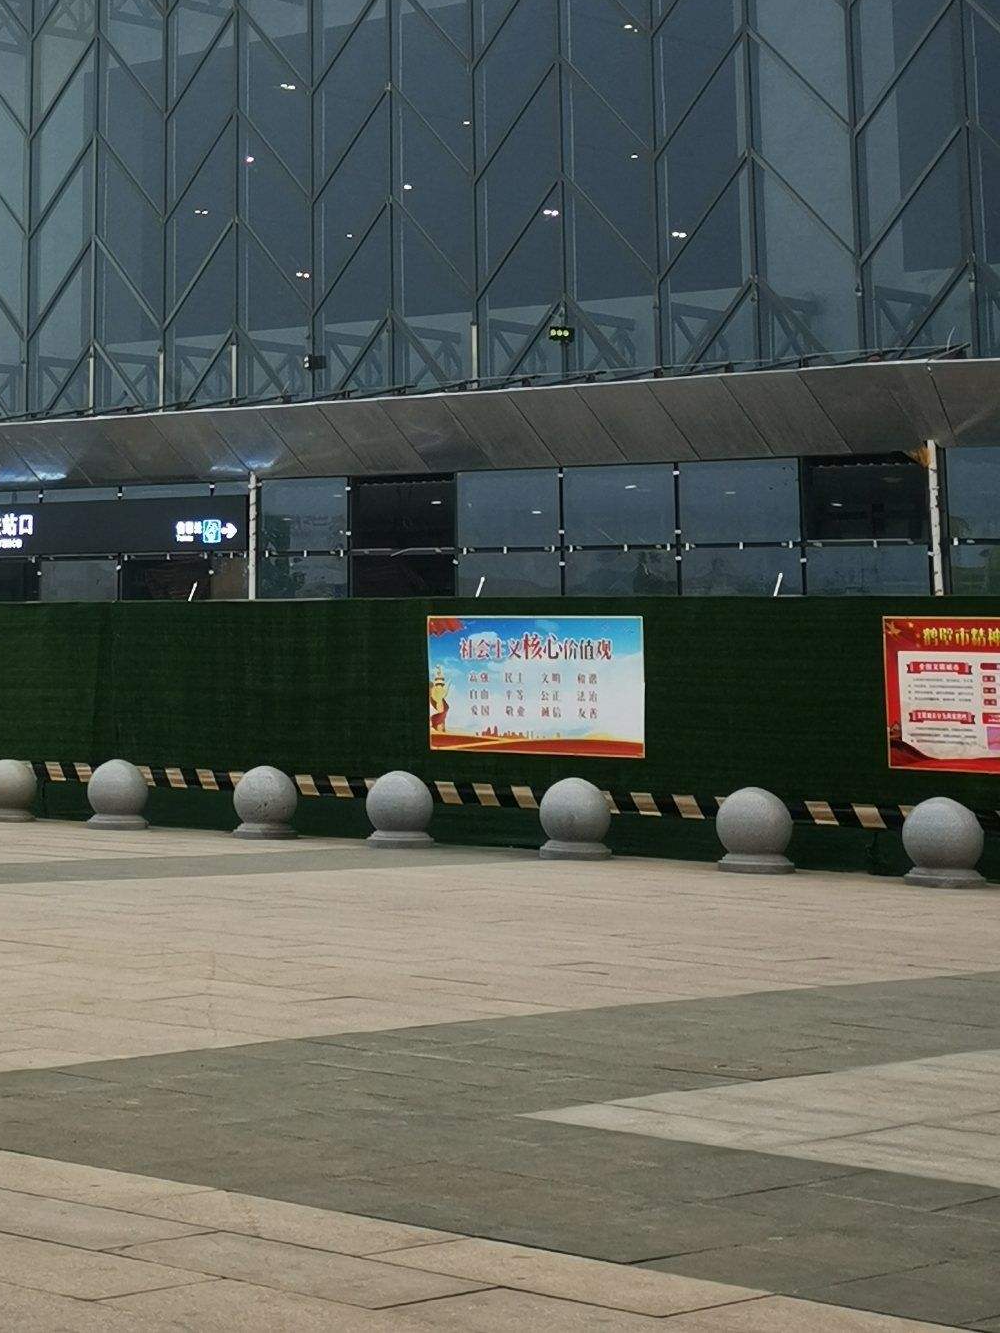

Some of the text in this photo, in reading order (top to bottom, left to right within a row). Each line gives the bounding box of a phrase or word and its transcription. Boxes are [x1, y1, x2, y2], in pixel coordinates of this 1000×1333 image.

[459, 633, 612, 661] 社会主义核心价值观
